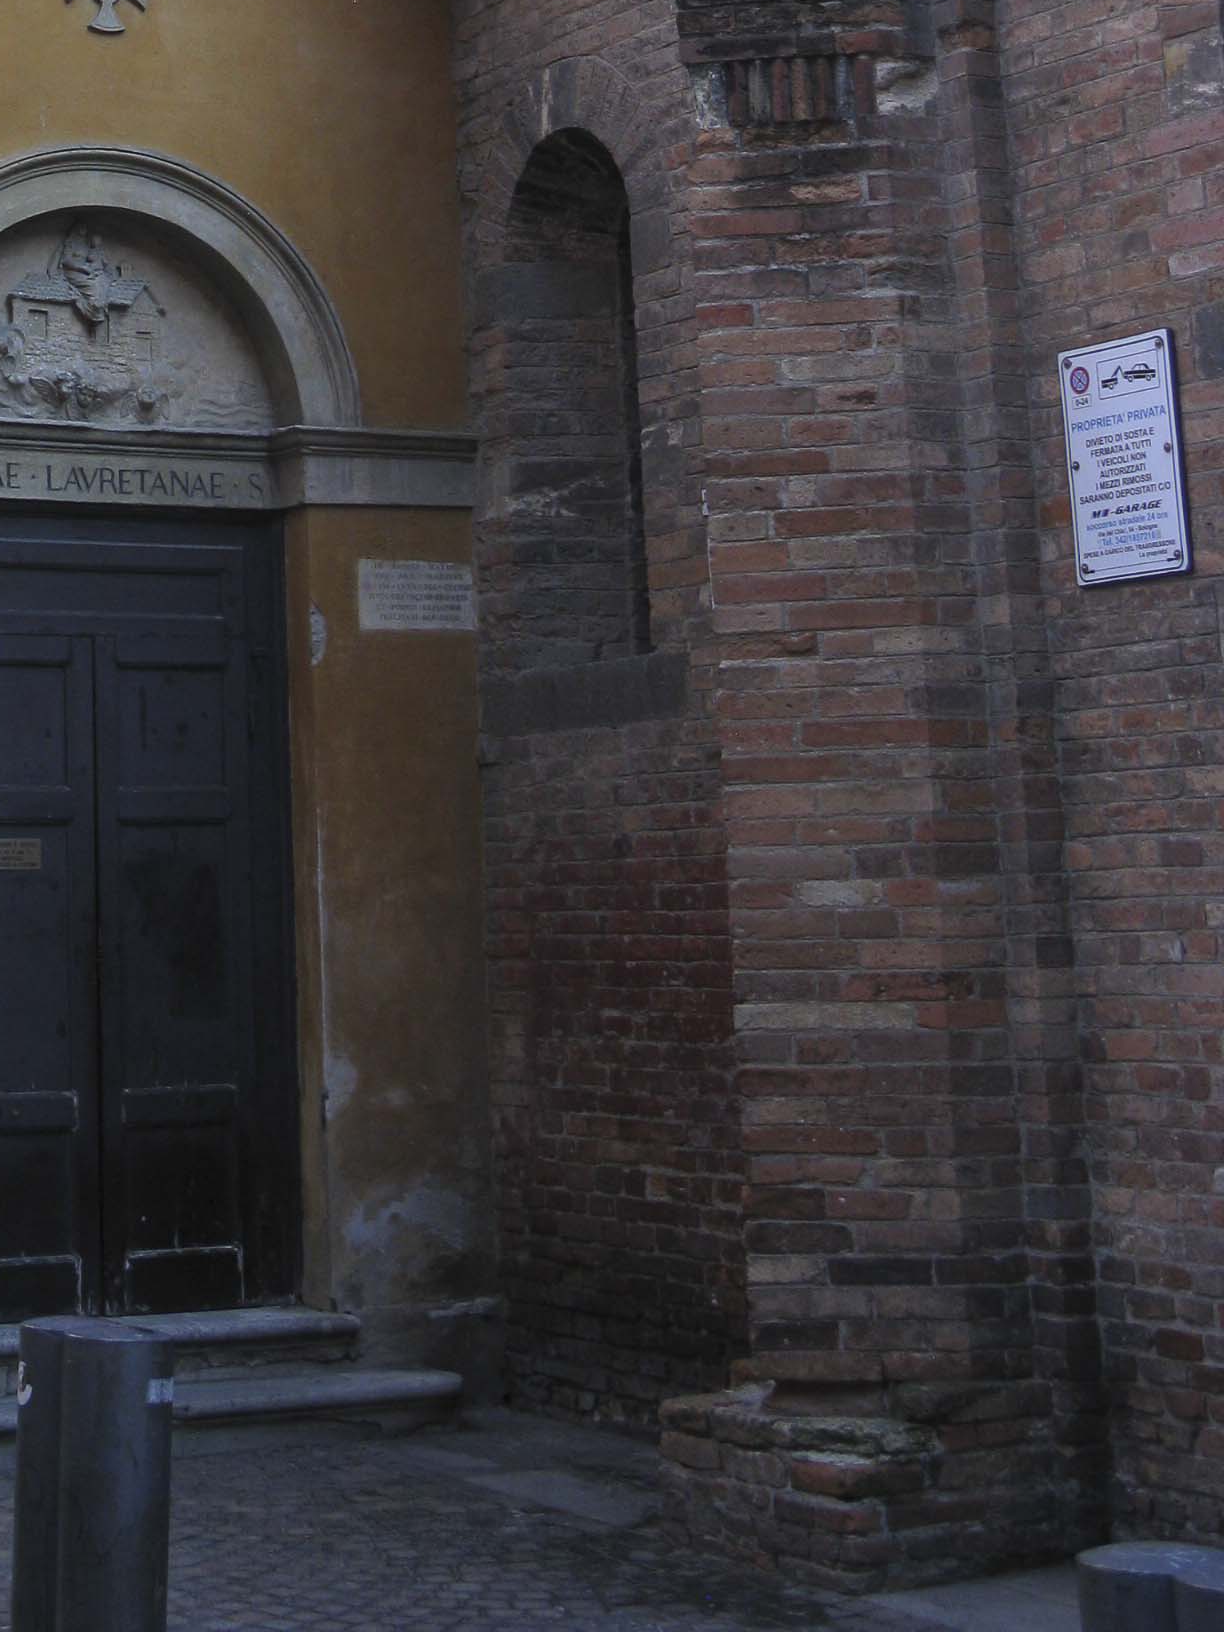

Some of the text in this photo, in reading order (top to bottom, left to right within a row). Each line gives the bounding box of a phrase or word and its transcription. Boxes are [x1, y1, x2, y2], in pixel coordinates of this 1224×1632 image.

[1071, 404, 1167, 433] PROPRIETA' PRIVATA
[1085, 434, 1115, 448] DIVIETO
[1116, 432, 1123, 442] DI
[1123, 428, 1148, 441] SOSTA
[1090, 444, 1123, 458] FERMATA
[1131, 439, 1152, 450] TUTTI
[1100, 454, 1129, 467] VEICOLI
[1131, 452, 1147, 462] NON
[1099, 462, 1147, 478] AUTORIZZATI
[46, 464, 225, 499] LAVRETANAE
[1099, 478, 1121, 490] MEZZI
[1121, 472, 1153, 486] RIMOSSI
[1079, 491, 1114, 505] SARANNO
[1115, 483, 1157, 499] DEPOSITATI
[1146, 512, 1156, 521] 24
